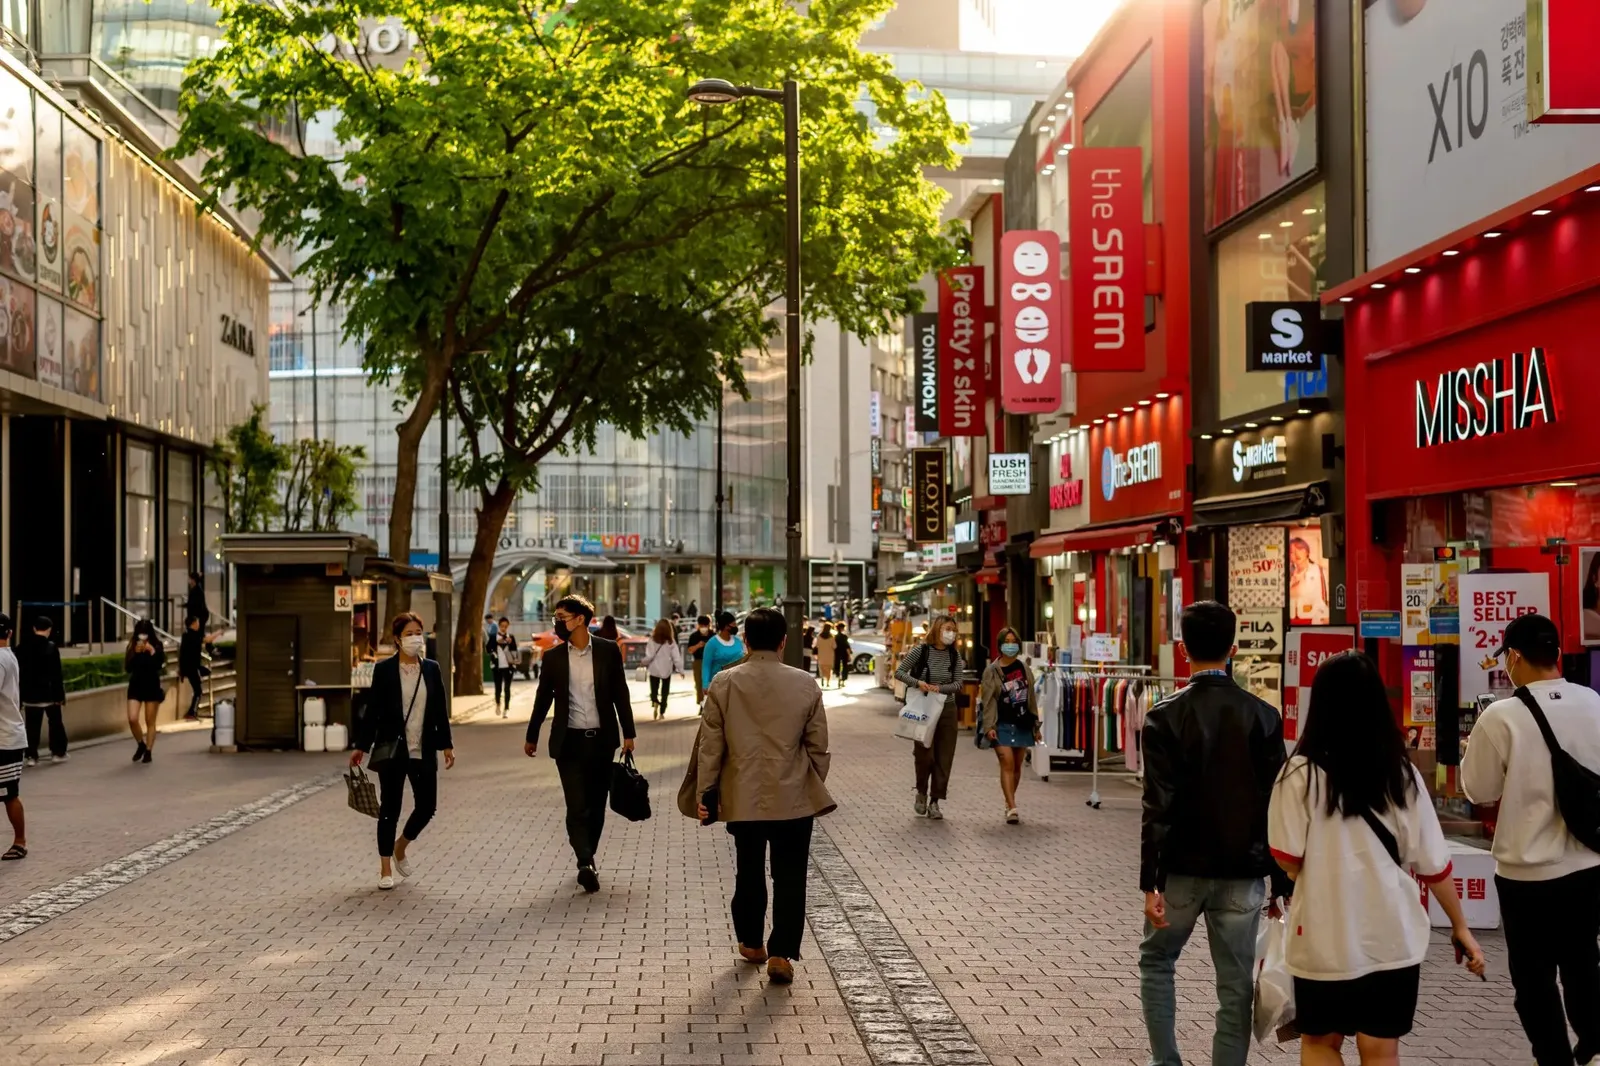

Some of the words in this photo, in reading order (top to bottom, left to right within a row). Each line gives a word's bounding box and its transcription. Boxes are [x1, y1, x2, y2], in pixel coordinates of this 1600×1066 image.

[1091, 169, 1121, 219] the
[949, 273, 975, 354] Pretty
[1270, 308, 1304, 348] S
[220, 314, 255, 357] ZARA
[922, 324, 936, 420] TONYMOLY
[1261, 350, 1313, 364] Market
[953, 375, 976, 428] skin
[1416, 347, 1549, 448] MISSHA
[992, 459, 1026, 468] LUSH
[992, 470, 1026, 478] FRESH
[1114, 453, 1130, 488] the
[926, 460, 939, 533] LLOYD
[1252, 559, 1283, 574] 50%
[1473, 591, 1517, 606] BEST
[1240, 621, 1274, 632] FILA
[1250, 640, 1265, 648] 2F
